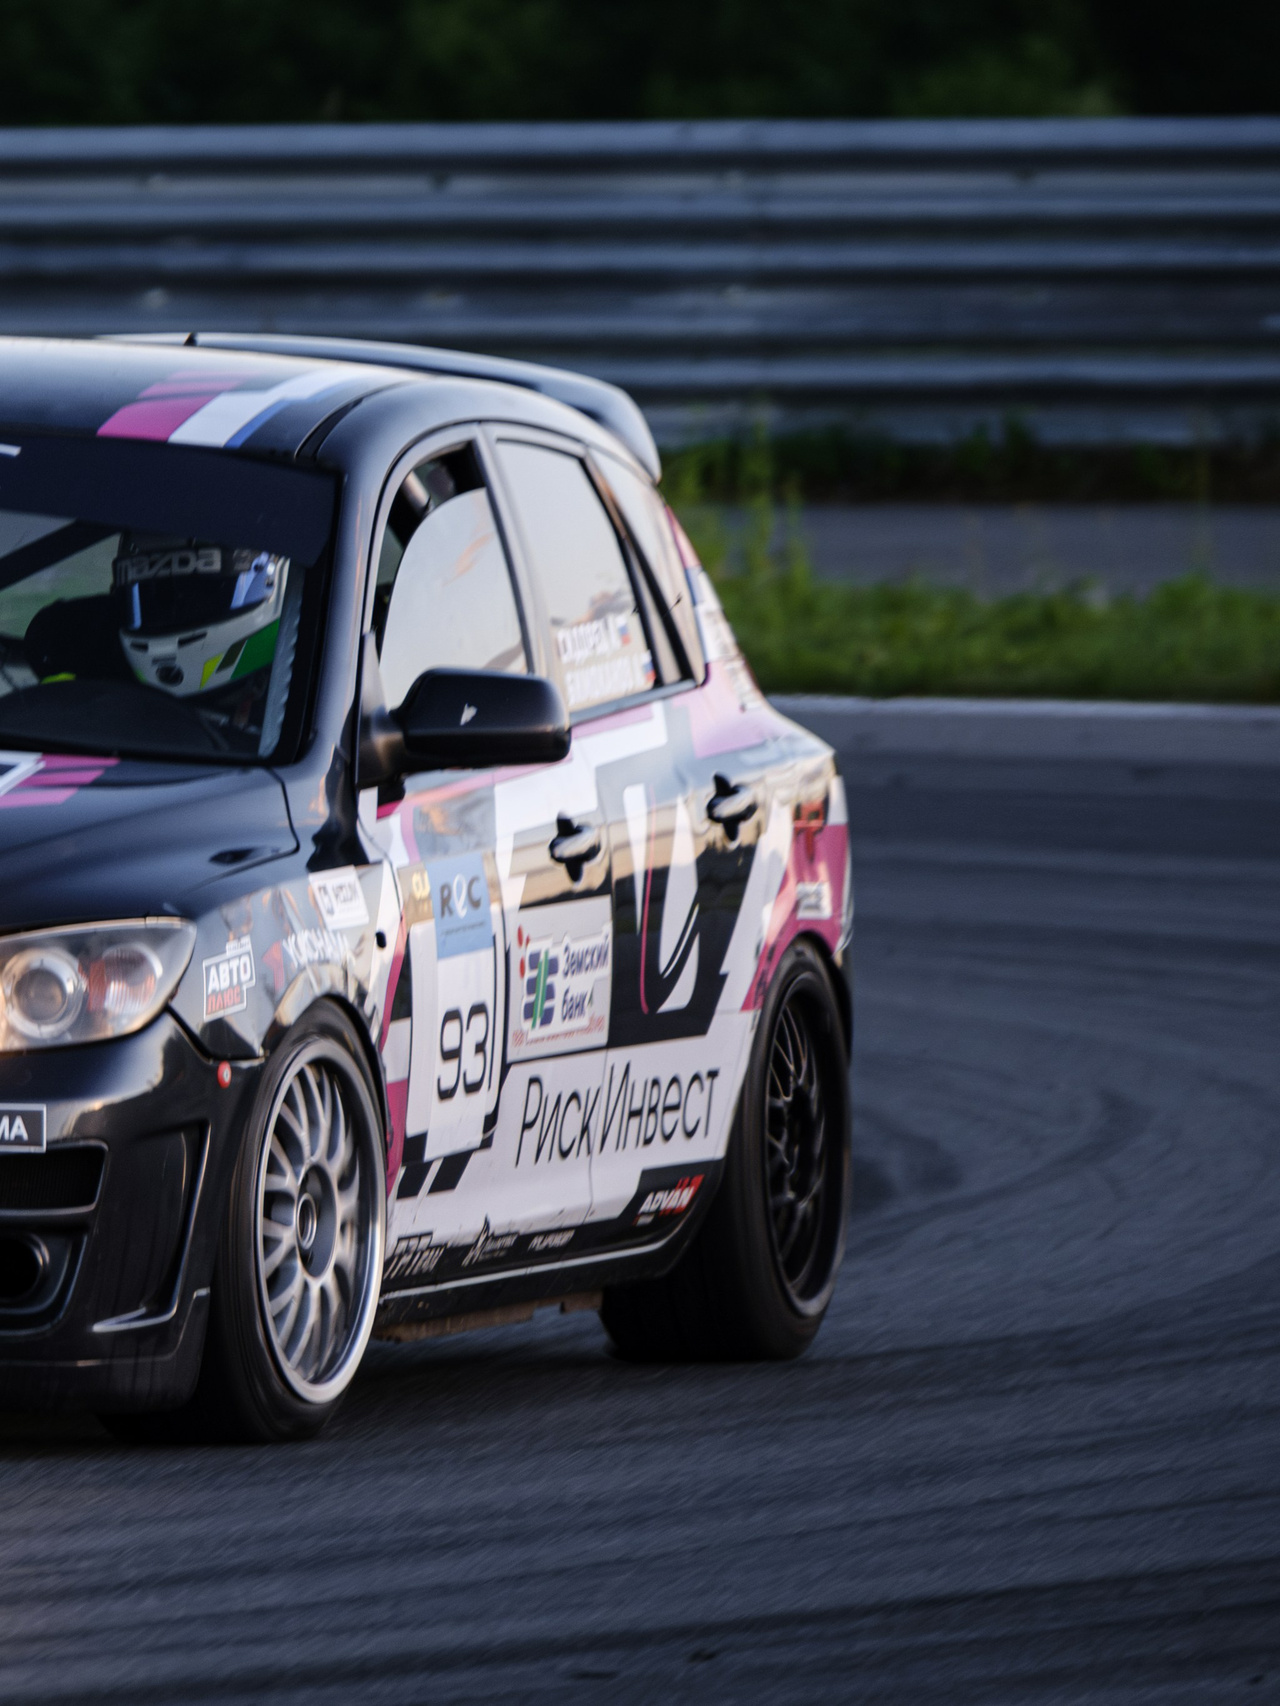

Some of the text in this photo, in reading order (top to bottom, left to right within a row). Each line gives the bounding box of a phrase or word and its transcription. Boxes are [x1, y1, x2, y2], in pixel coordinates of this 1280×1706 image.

[562, 933, 610, 978] Земский
[437, 1001, 490, 1101] 93
[637, 1185, 695, 1215] ADVAN
